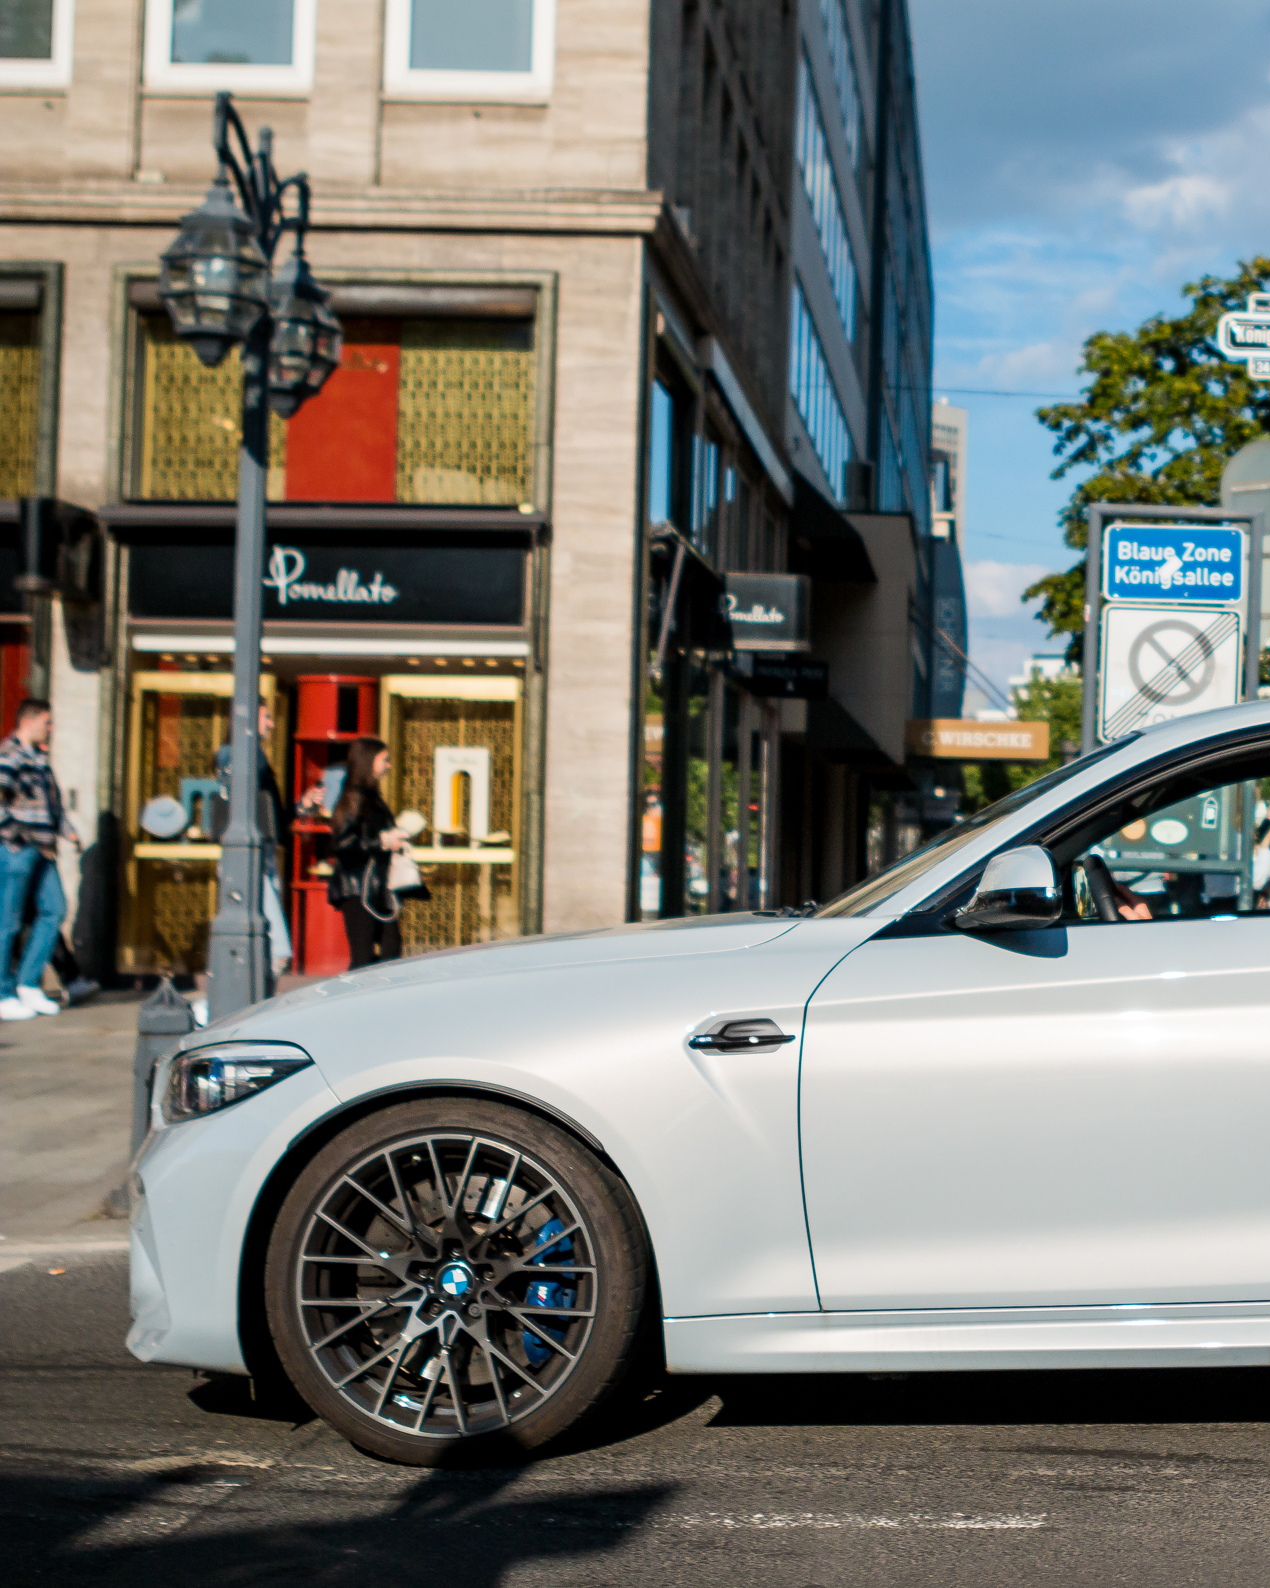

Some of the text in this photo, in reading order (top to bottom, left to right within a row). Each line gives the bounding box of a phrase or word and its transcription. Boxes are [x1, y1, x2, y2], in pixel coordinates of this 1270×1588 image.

[1117, 540, 1232, 563] Blaue Zone
[262, 543, 397, 605] Pomellato
[937, 731, 1032, 750] WIRSCHKE
